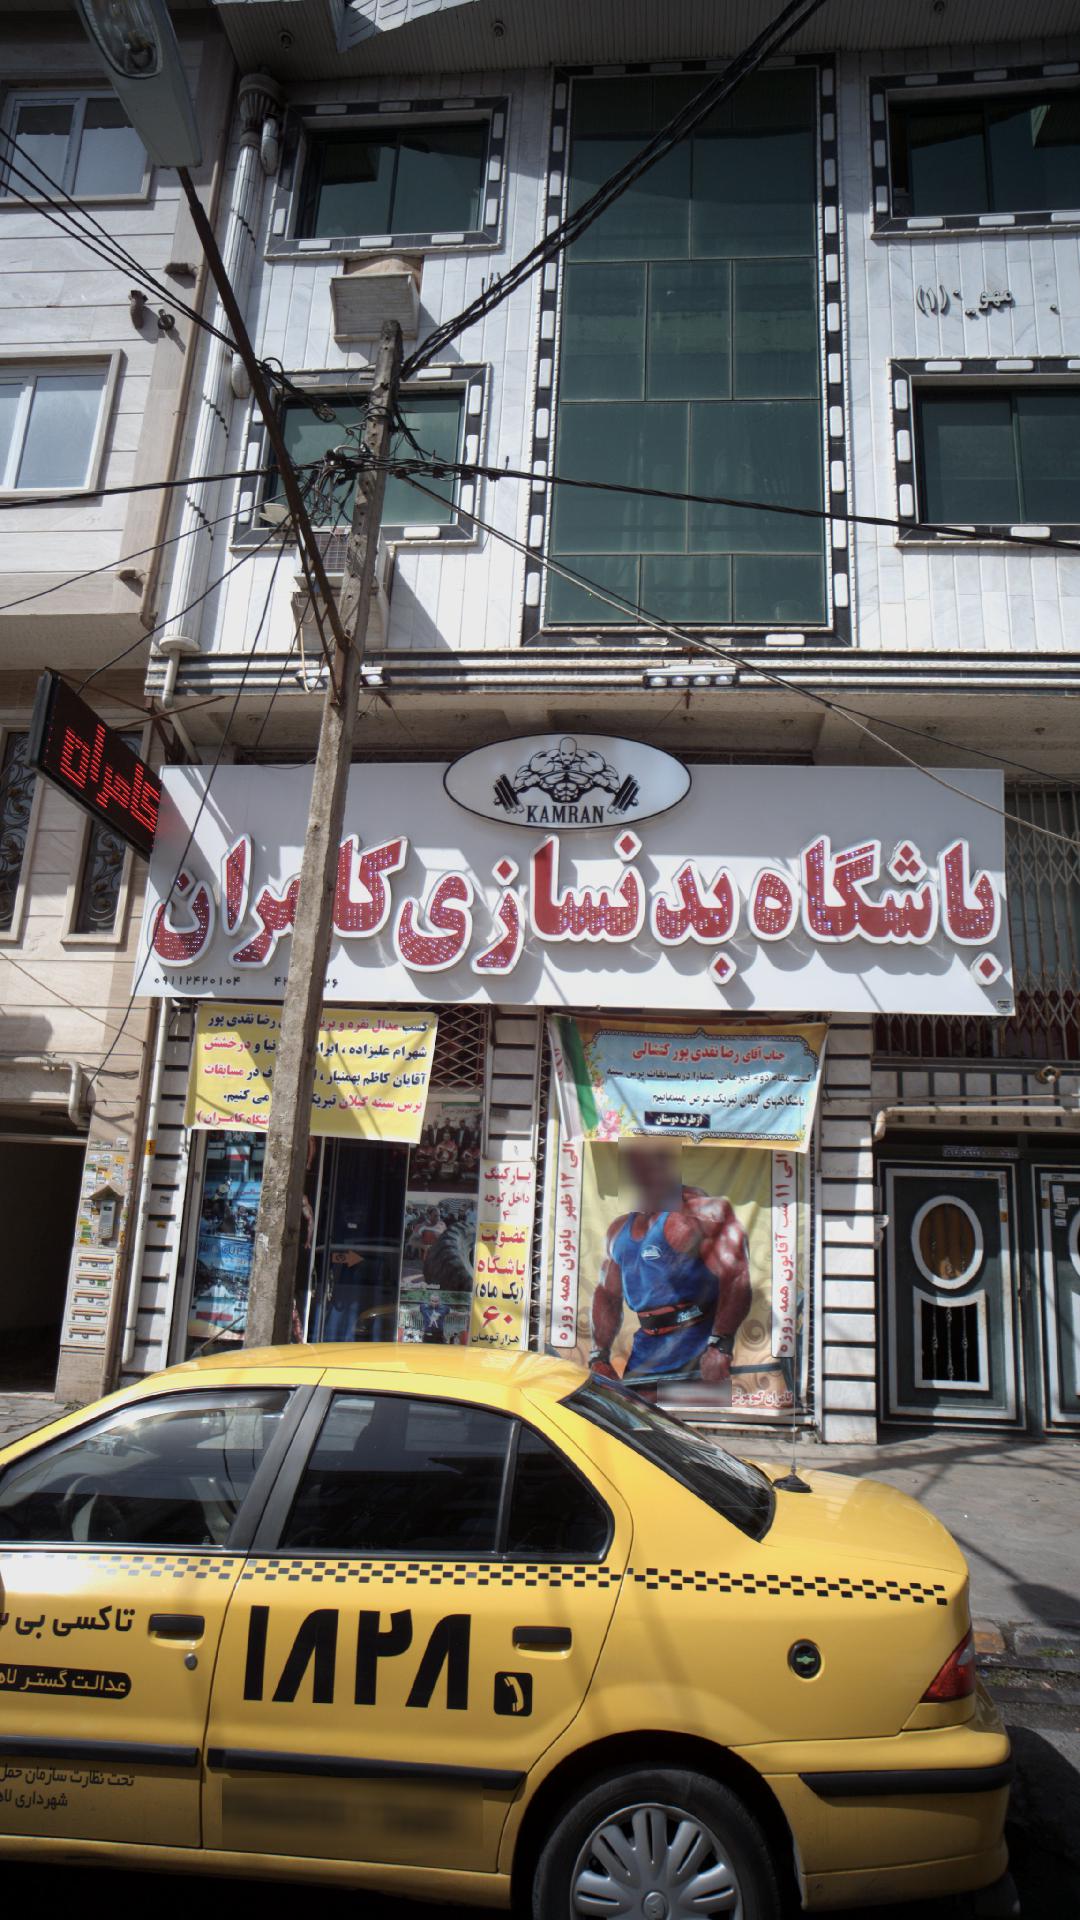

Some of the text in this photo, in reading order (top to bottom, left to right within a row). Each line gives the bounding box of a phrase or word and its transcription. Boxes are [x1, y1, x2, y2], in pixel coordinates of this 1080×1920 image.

[526, 805, 604, 823] KAMRAN
[748, 834, 1003, 986] باشگاه
[208, 1015, 225, 1027] پور
[227, 1012, 254, 1027] نقدی
[256, 1014, 276, 1029] رضا
[346, 1019, 369, 1033] نقره
[372, 1018, 399, 1033] مدال
[402, 1021, 428, 1034] کسب
[204, 1036, 251, 1053] درخشش
[349, 1044, 390, 1058] علیزاده
[393, 1046, 427, 1061] شهرام
[204, 1063, 244, 1078] مسابقات
[247, 1068, 259, 1080] در
[363, 1071, 390, 1086] کاظم
[393, 1072, 426, 1087] آقایان
[252, 1094, 269, 1104] می
[484, 1192, 529, 1208] داخل کوچه
[558, 1229, 577, 1271] بانوان
[477, 1257, 525, 1281] باشگاه
[483, 1305, 513, 1328] ۶۰
[558, 1306, 574, 1341] روزه
[779, 1317, 794, 1353] روزه
[15, 1614, 46, 1639] بی
[52, 1605, 136, 1637] تاکسی
[243, 1604, 472, 1711] ۱۸۲۸
[20, 1669, 68, 1690] گستر
[71, 1674, 126, 1693] عدالت
[25, 1764, 67, 1786] سازمان
[70, 1769, 105, 1788] نظارت
[107, 1774, 136, 1786] تحت
[15, 1792, 69, 1810] شهرداری
